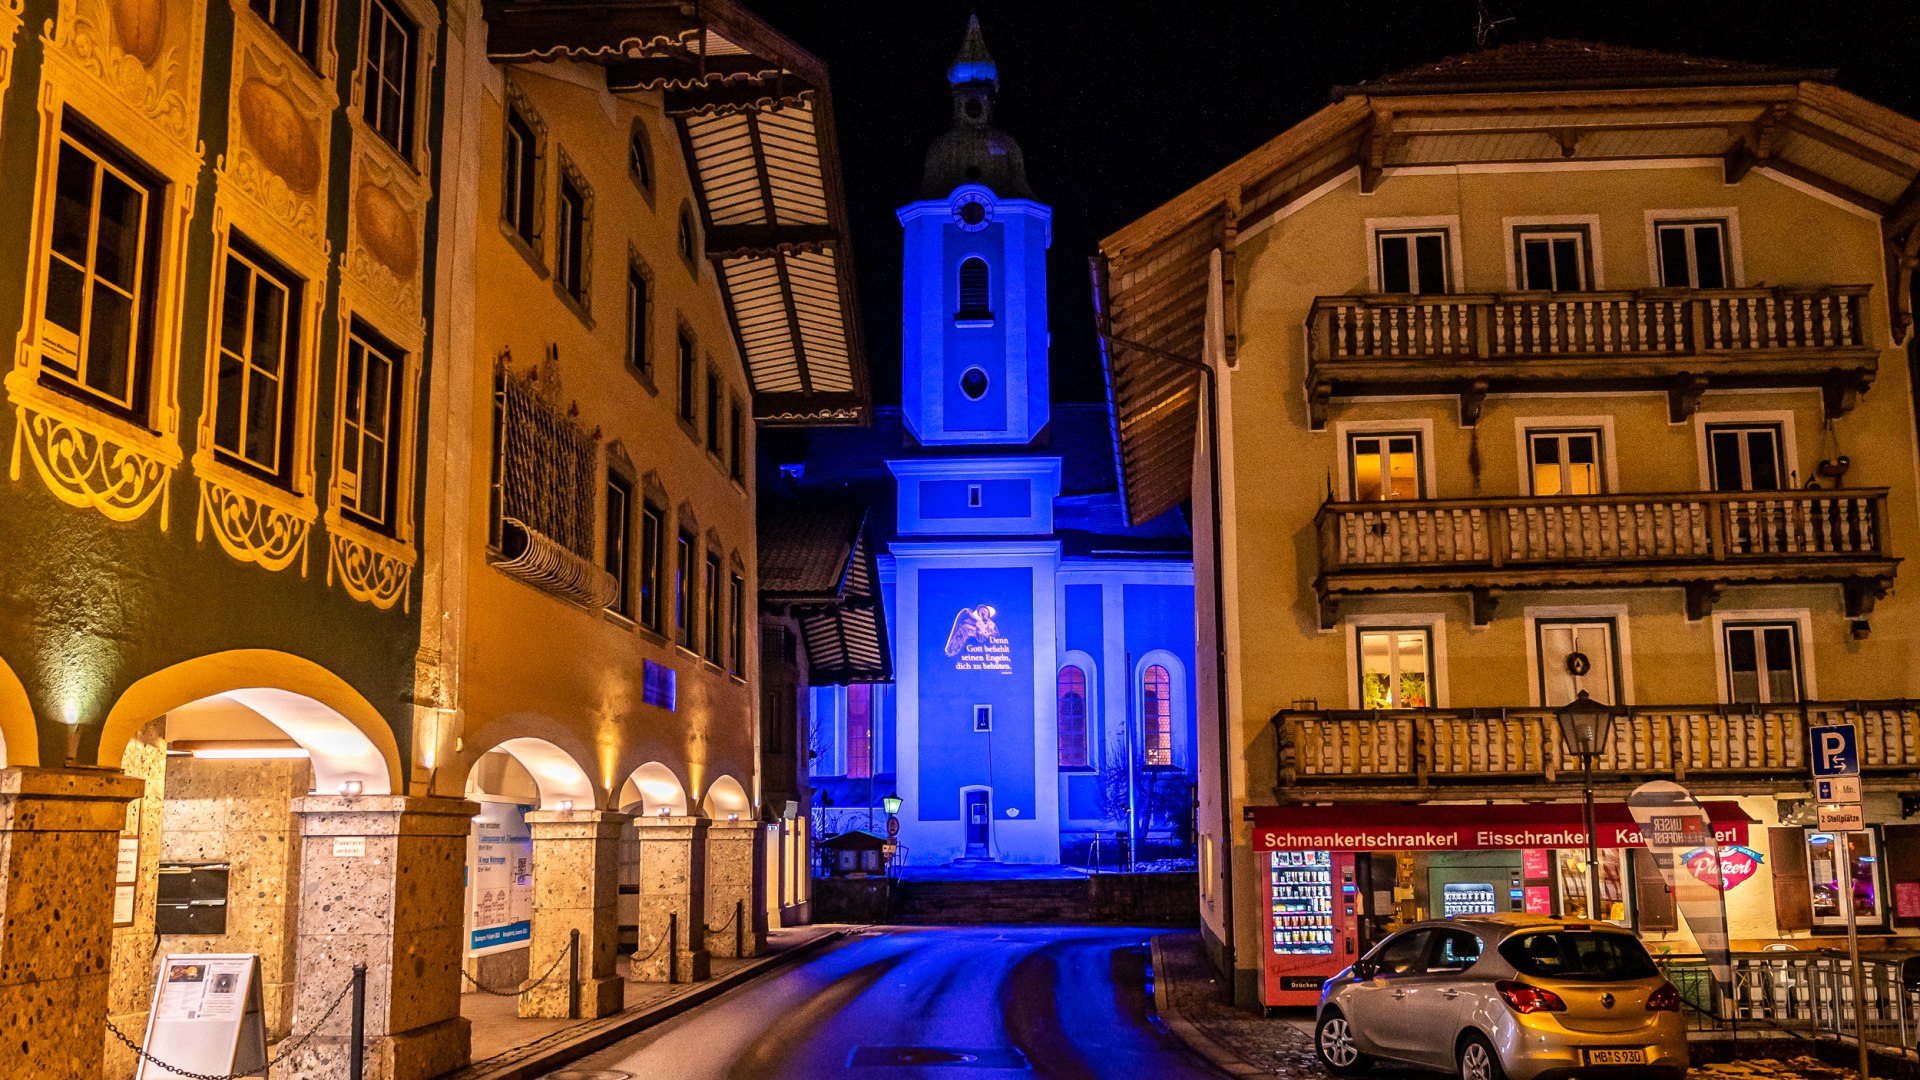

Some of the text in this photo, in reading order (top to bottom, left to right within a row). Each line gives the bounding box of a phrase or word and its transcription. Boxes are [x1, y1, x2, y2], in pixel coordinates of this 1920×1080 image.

[989, 636, 1009, 644] Denn
[966, 644, 1010, 653] Gott befiehlt
[956, 662, 972, 670] dich
[1821, 732, 1846, 770] P
[1821, 814, 1860, 825] 2 Stellplätze
[1264, 831, 1458, 848] Schmankerlschrankerl
[1477, 830, 1591, 846] Eisschranker
[1593, 1051, 1641, 1063] MB S 930
